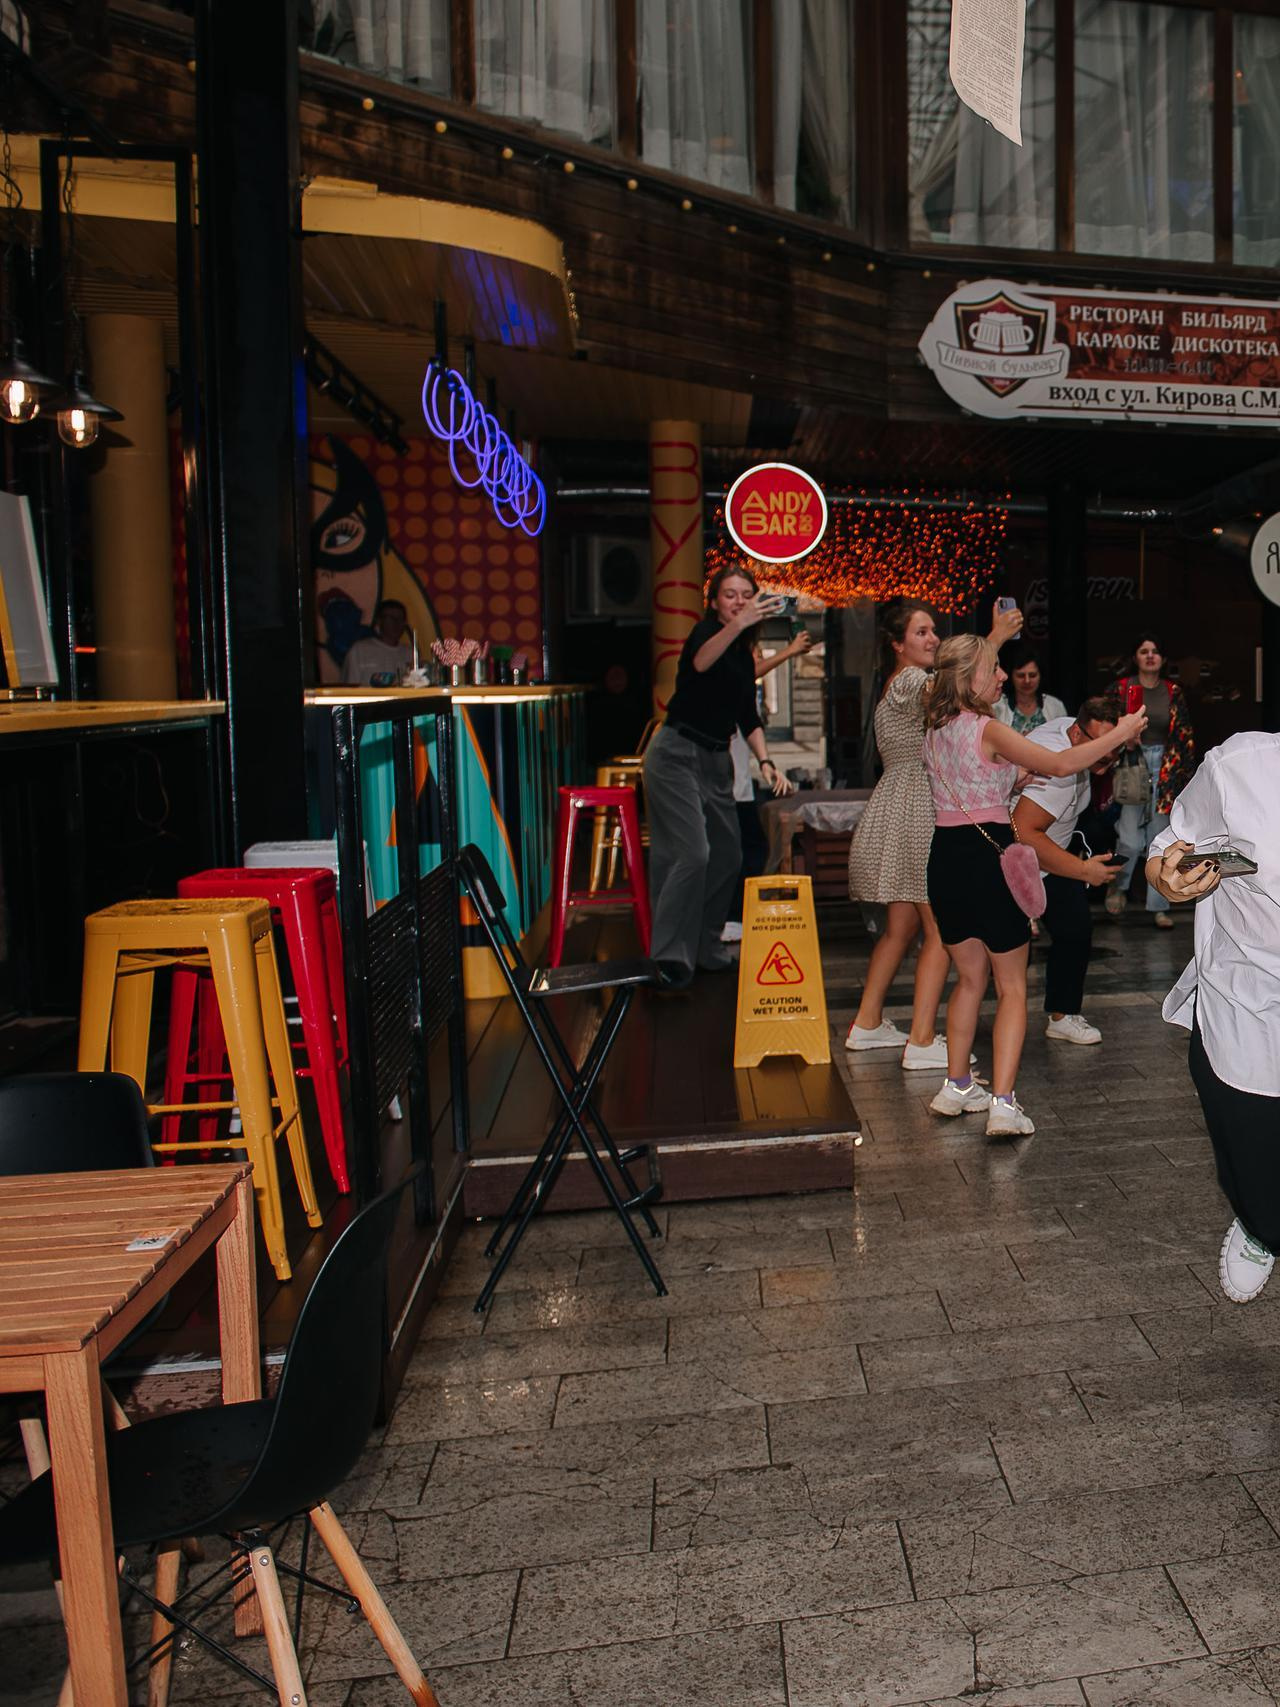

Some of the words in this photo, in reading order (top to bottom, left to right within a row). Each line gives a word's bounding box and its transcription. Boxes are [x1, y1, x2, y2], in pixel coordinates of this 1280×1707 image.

[1069, 304, 1164, 325] РЕСТОРАН
[1181, 311, 1267, 333] БИЛЬЯРД
[1076, 332, 1161, 351] КАРАОКЕ
[1171, 336, 1280, 357] ДИСКОТЕКА
[944, 349, 997, 370] Пивной
[1048, 387, 1099, 405] вход
[1104, 388, 1116, 402] с
[1120, 387, 1150, 407] ул.
[1156, 386, 1236, 410] Кирова
[740, 490, 813, 513] ANDY
[742, 513, 797, 537] BAR
[752, 924, 787, 932] мокрый
[755, 915, 803, 924] осторожно
[753, 1006, 773, 1015] WET
[778, 1005, 809, 1014] FLOOR
[759, 996, 802, 1006] CAUTION
